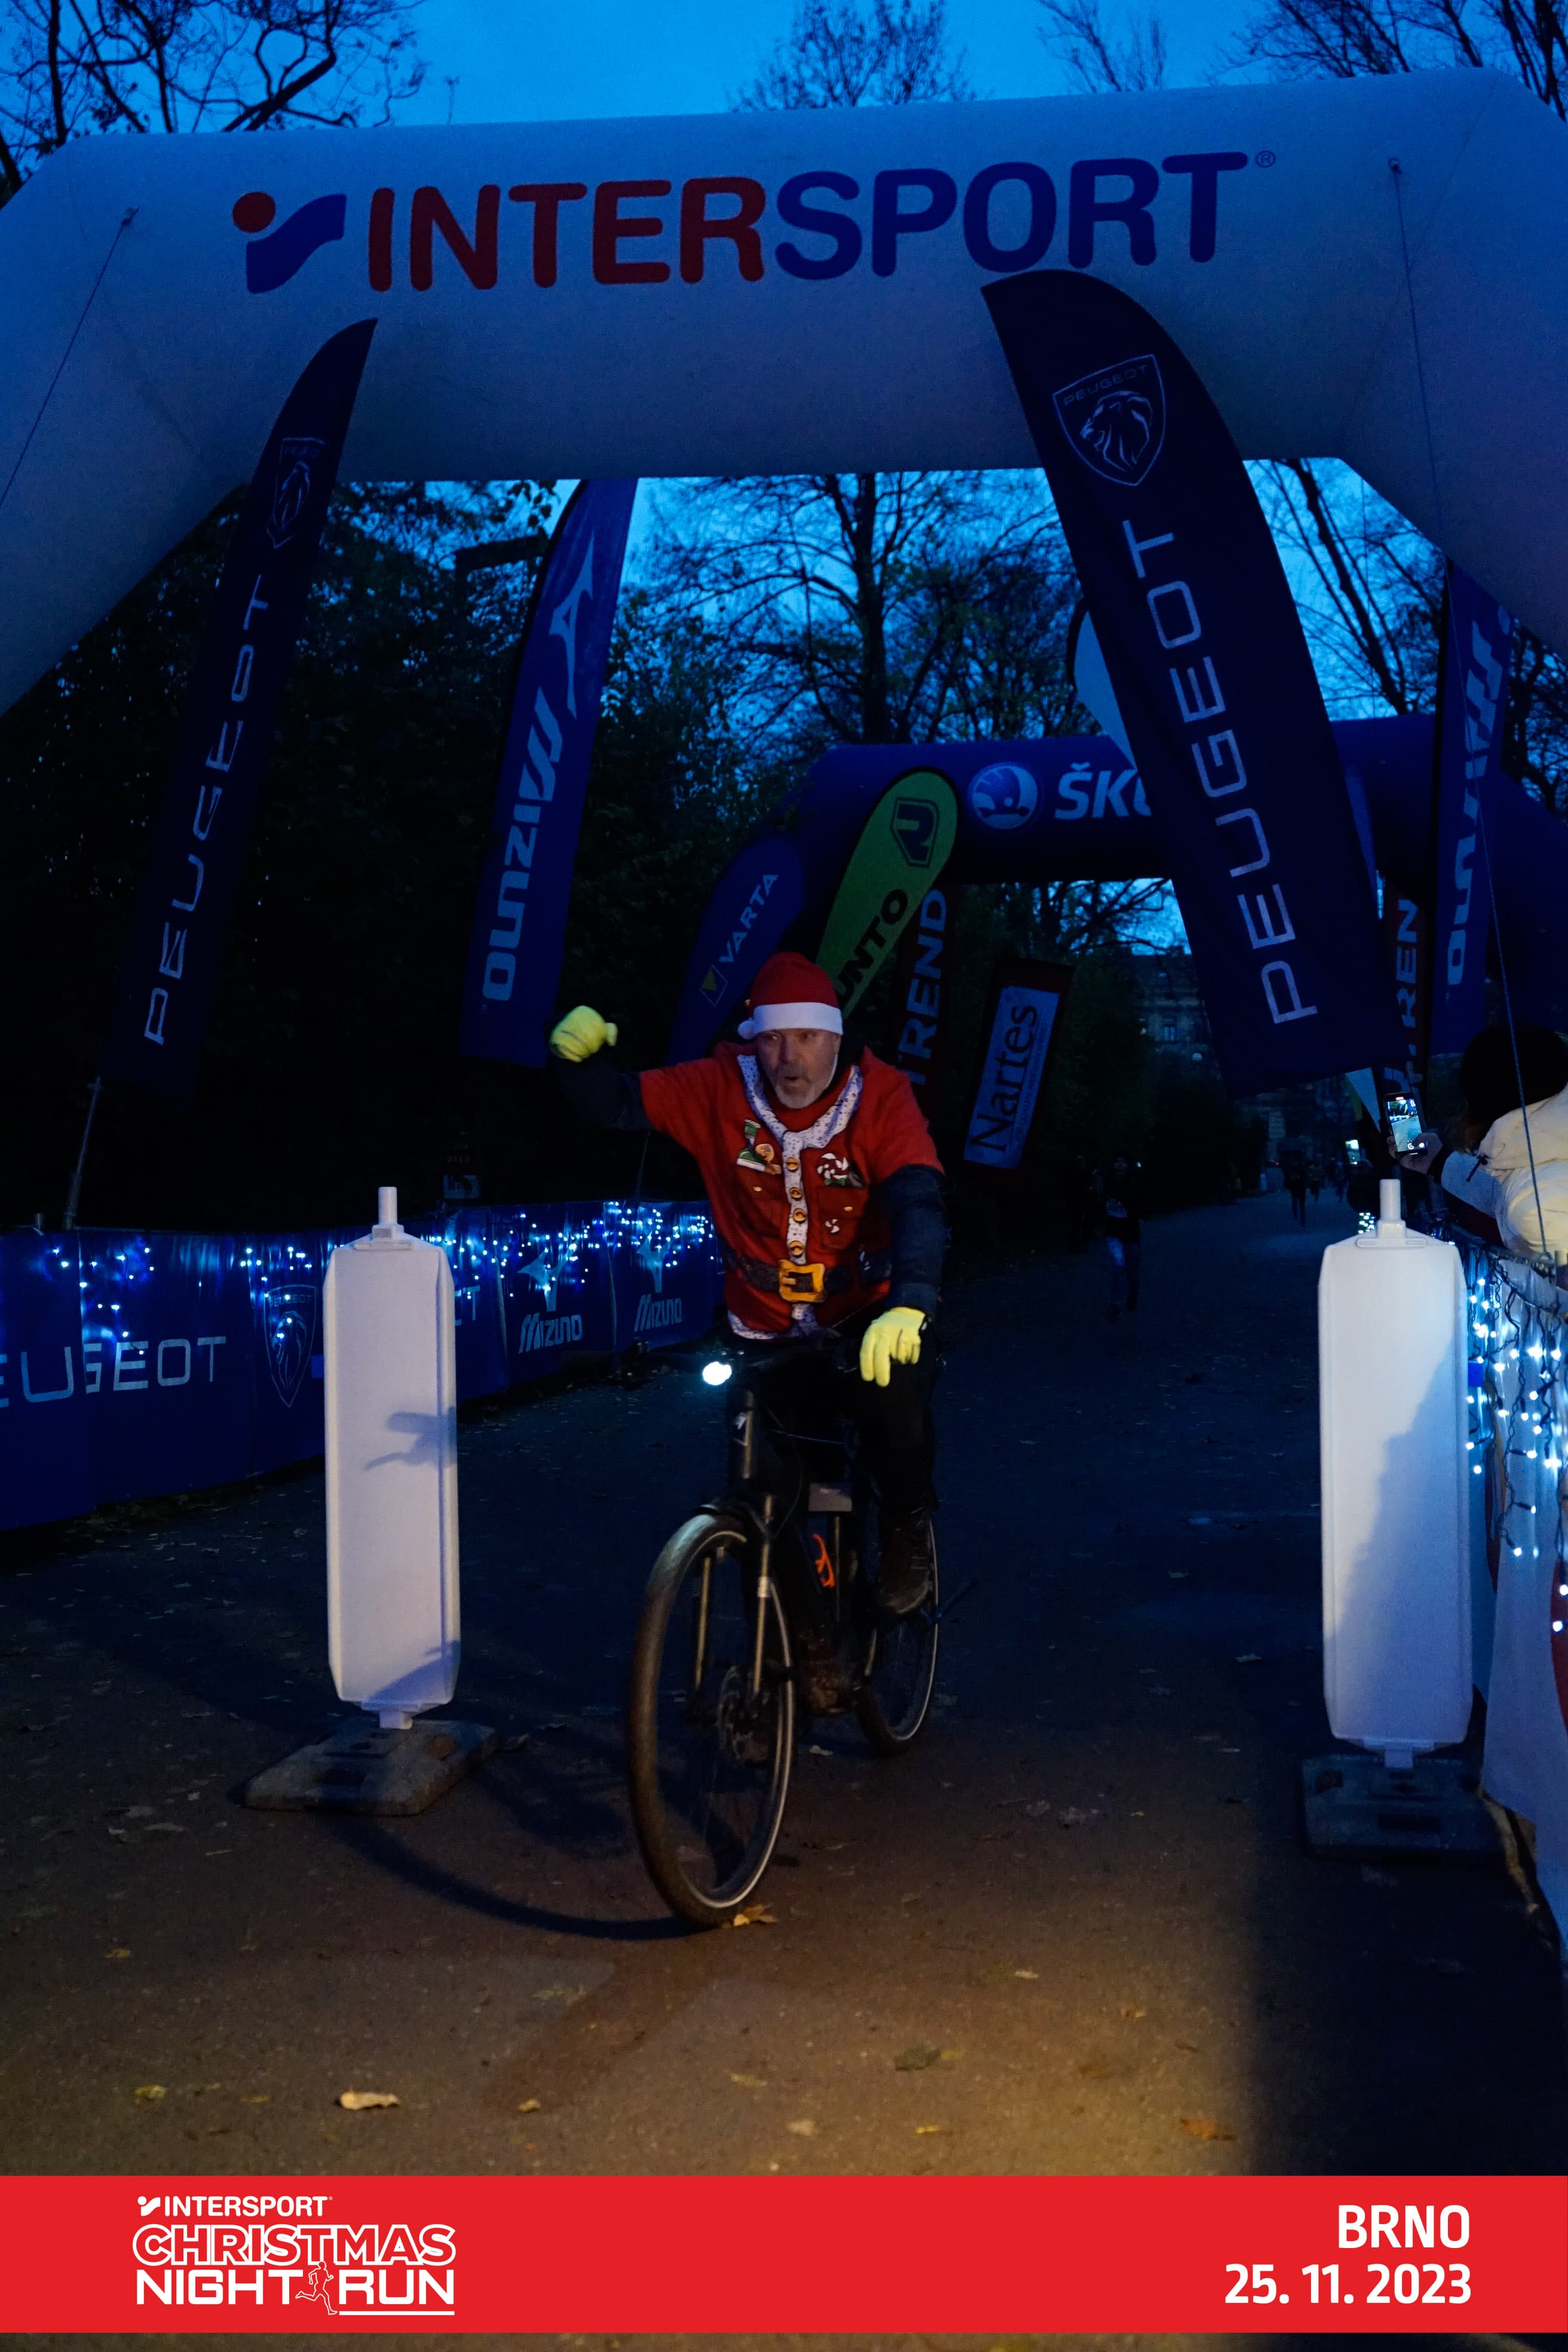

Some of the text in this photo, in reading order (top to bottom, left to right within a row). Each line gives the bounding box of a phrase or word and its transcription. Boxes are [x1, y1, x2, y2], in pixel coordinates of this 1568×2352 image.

[368, 151, 1248, 292] INTERSPORT
[1063, 364, 1148, 407] PEUGEOT
[143, 573, 269, 1047] PEUGEOT
[481, 686, 564, 1002] MIZUNO
[1122, 515, 1319, 1026] PEUGEOT
[718, 874, 779, 963] VARTA
[969, 1004, 1039, 1152] Nartes
